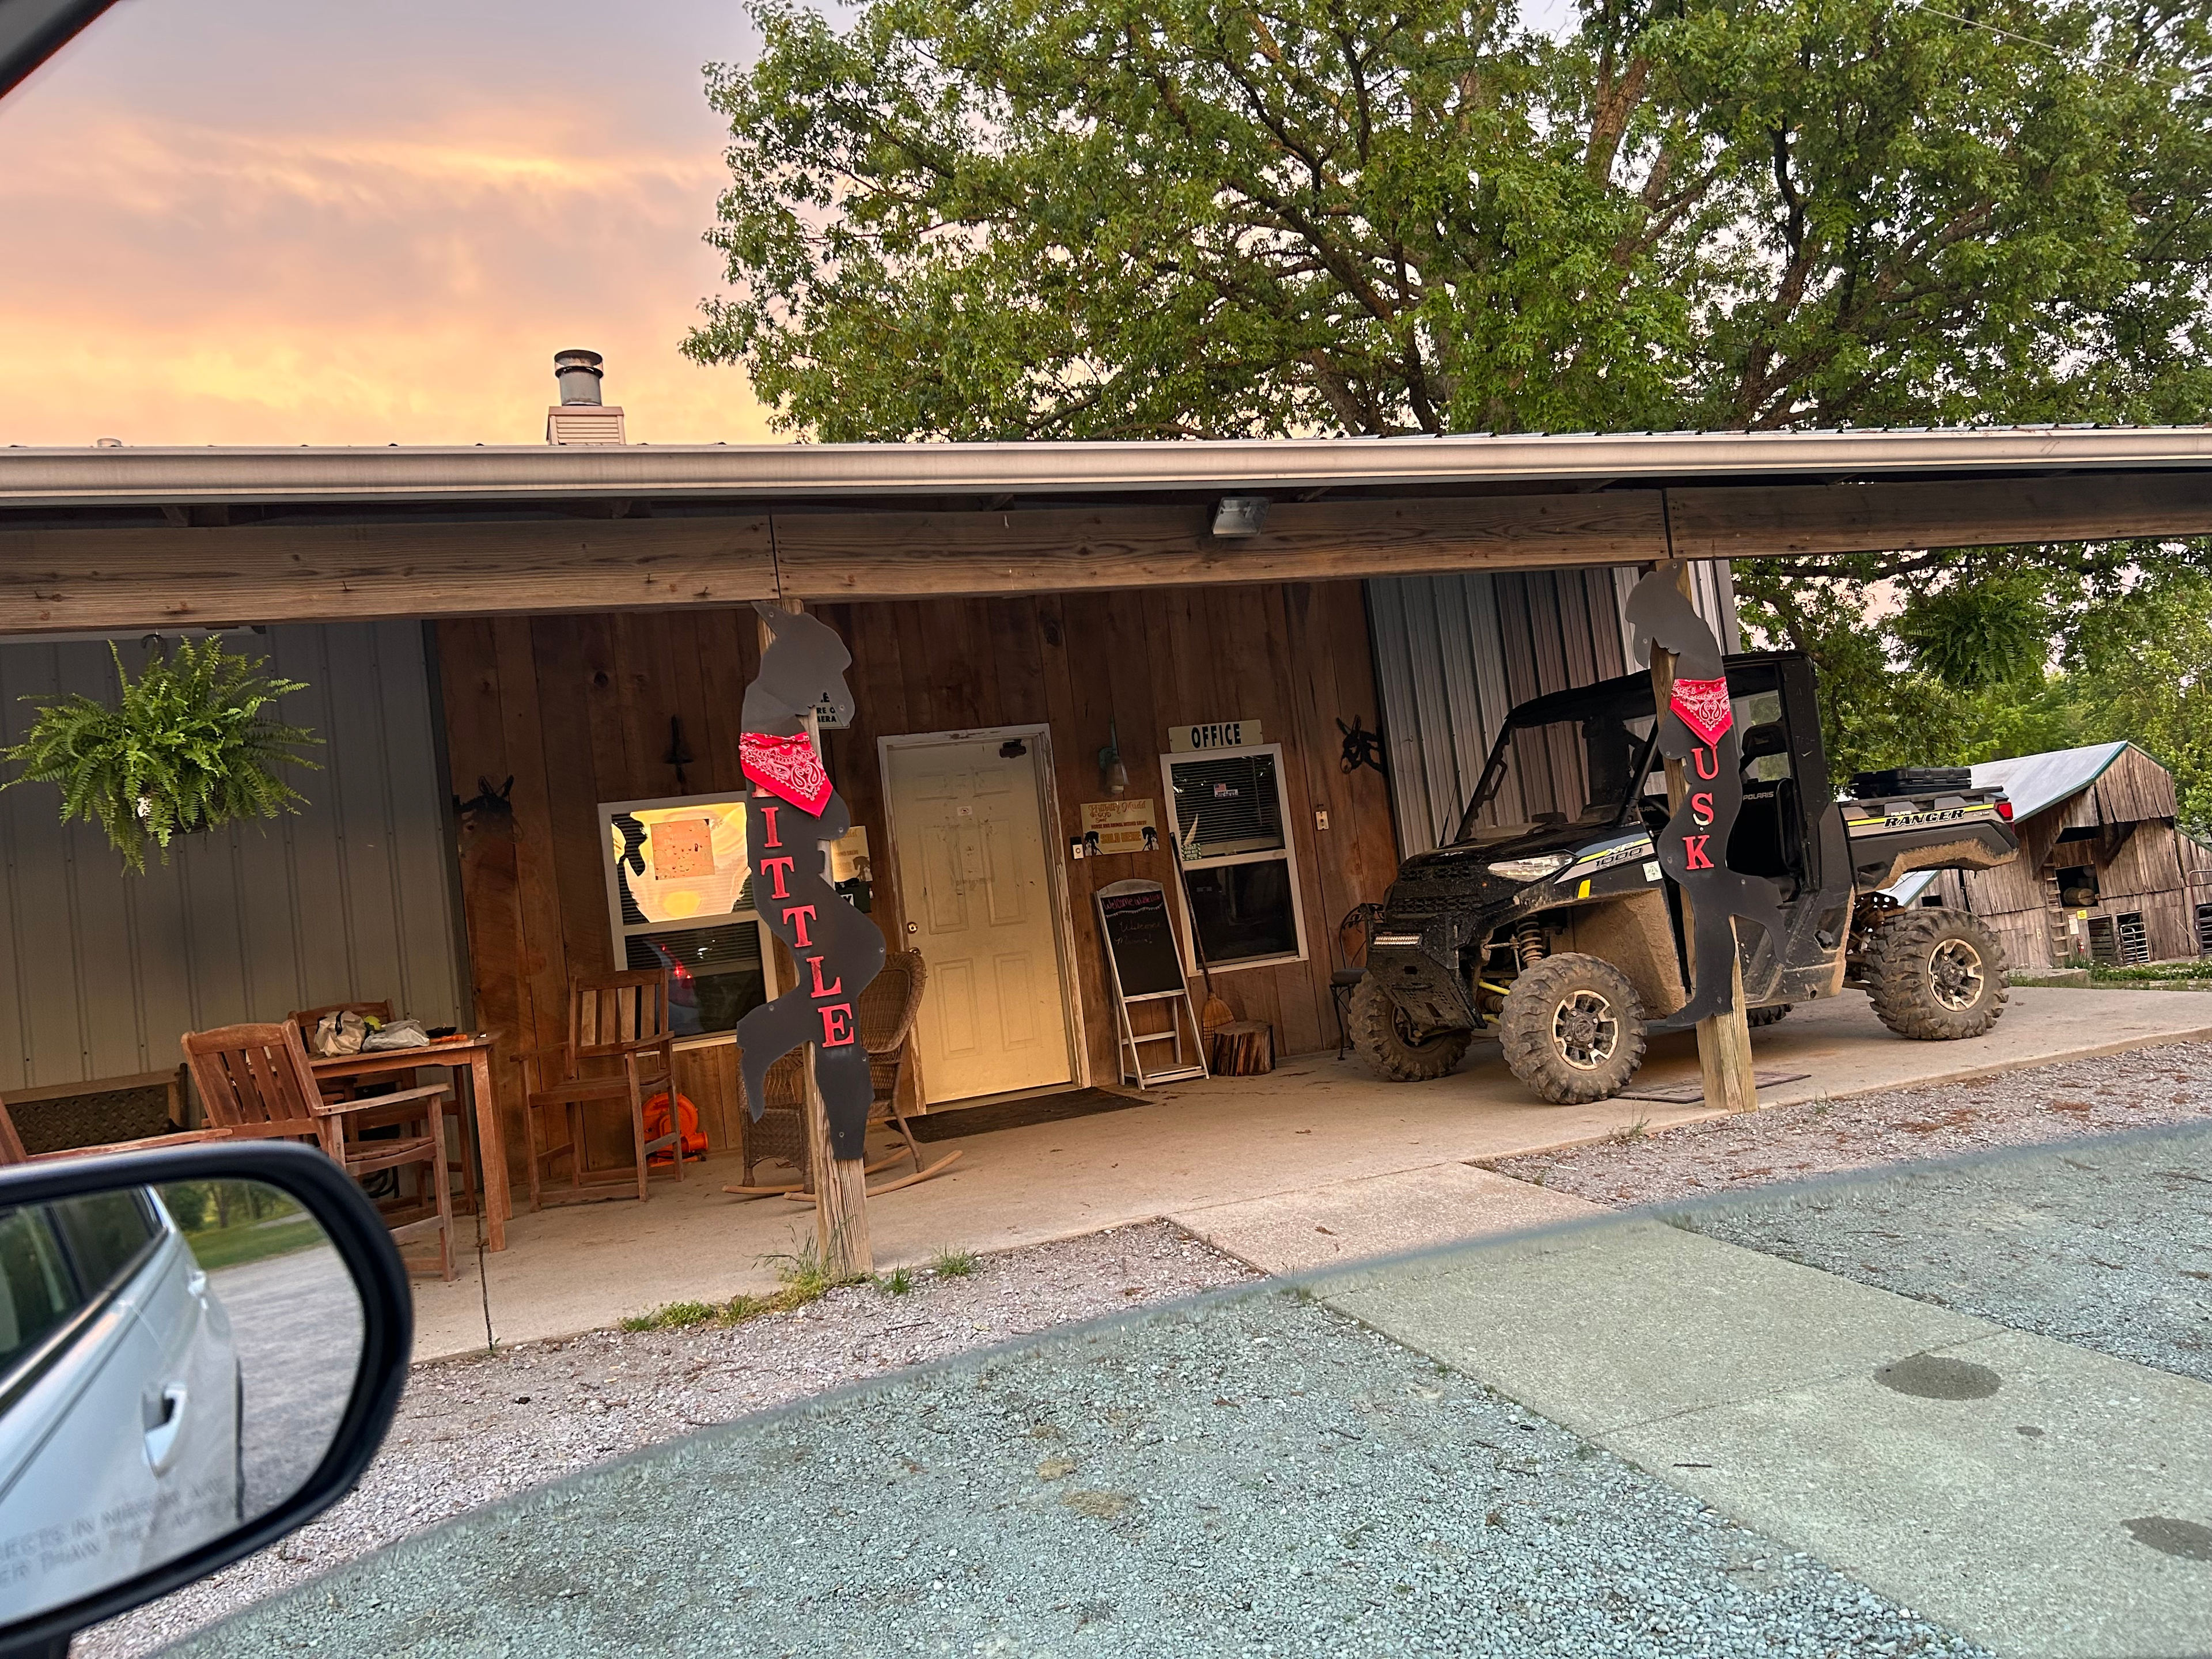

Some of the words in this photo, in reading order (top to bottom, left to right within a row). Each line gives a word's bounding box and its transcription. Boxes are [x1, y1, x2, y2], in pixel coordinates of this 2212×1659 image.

[1191, 724, 1241, 748] OFFICE
[1743, 791, 1774, 801] POLARIS
[1682, 745, 1719, 870] USK
[1883, 809, 1965, 829] RANGER
[1596, 847, 1643, 868] 1000
[1604, 842, 1636, 857] XP
[751, 788, 855, 1048] ITTLE
